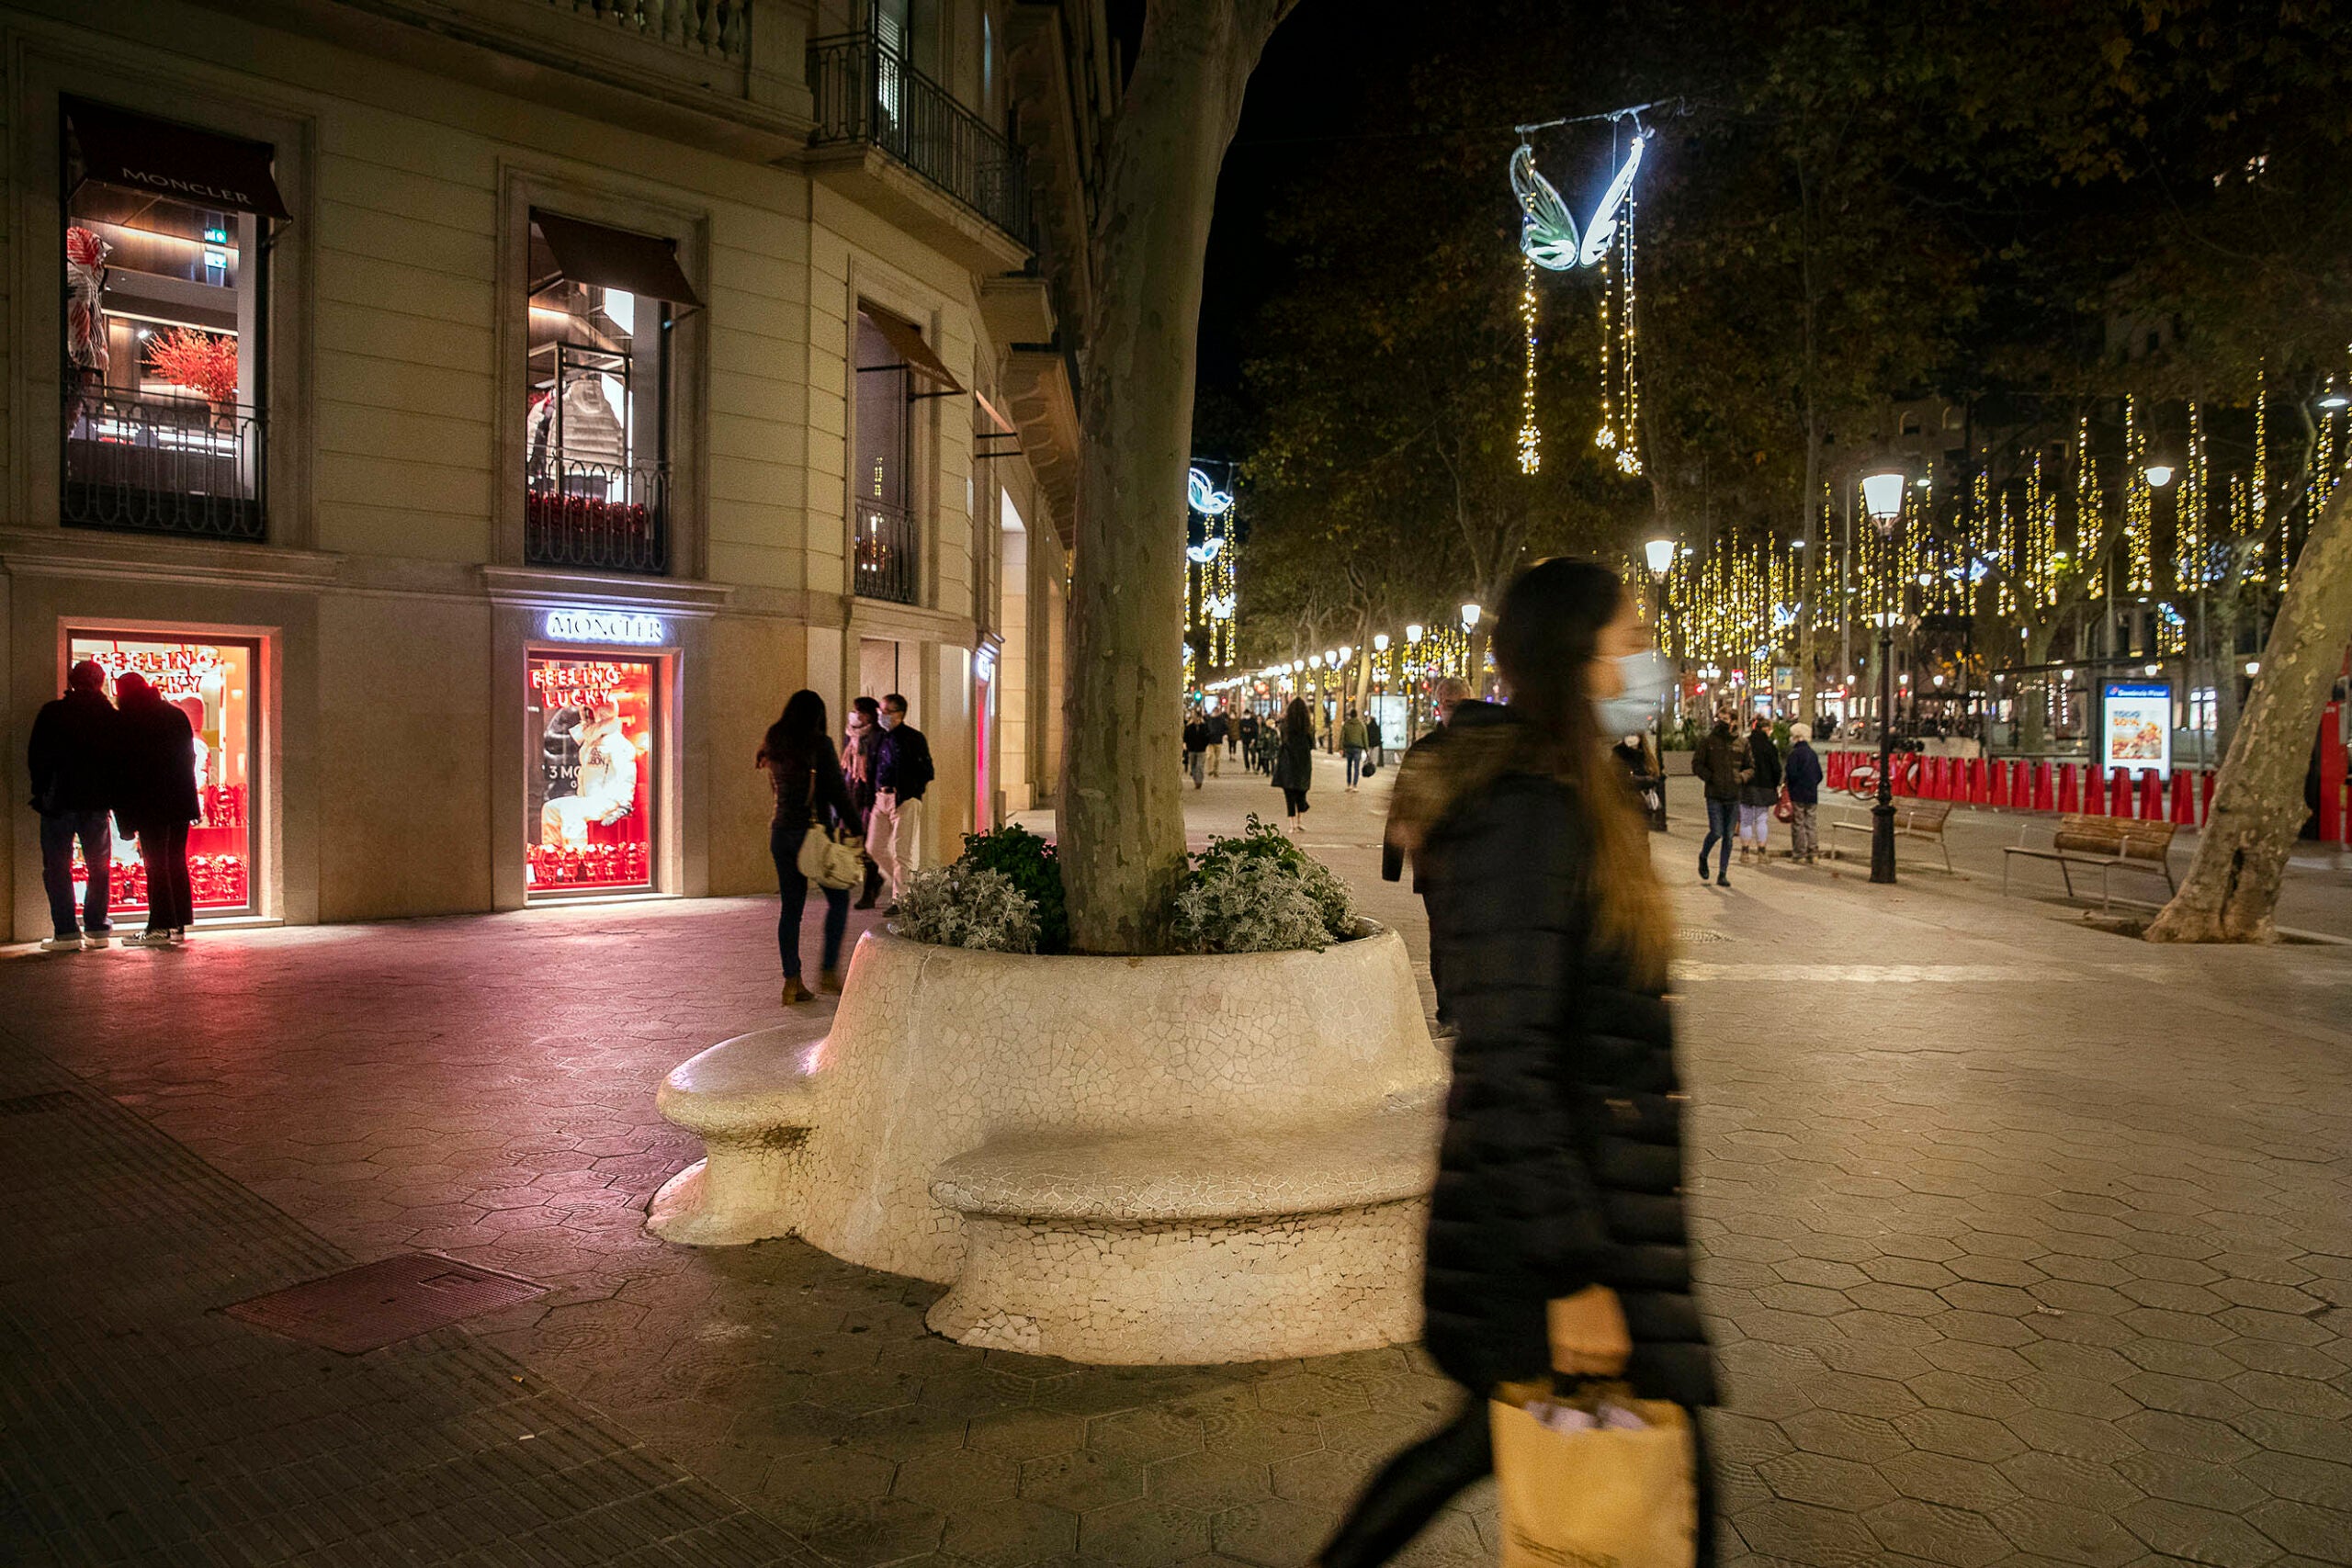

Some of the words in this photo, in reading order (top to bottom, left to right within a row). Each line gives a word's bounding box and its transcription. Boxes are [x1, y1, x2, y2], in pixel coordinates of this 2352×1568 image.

[122, 168, 252, 205] MONCLER
[530, 666, 623, 690] FEELING
[544, 687, 613, 709] LUCKY
[548, 765, 558, 779] 3
